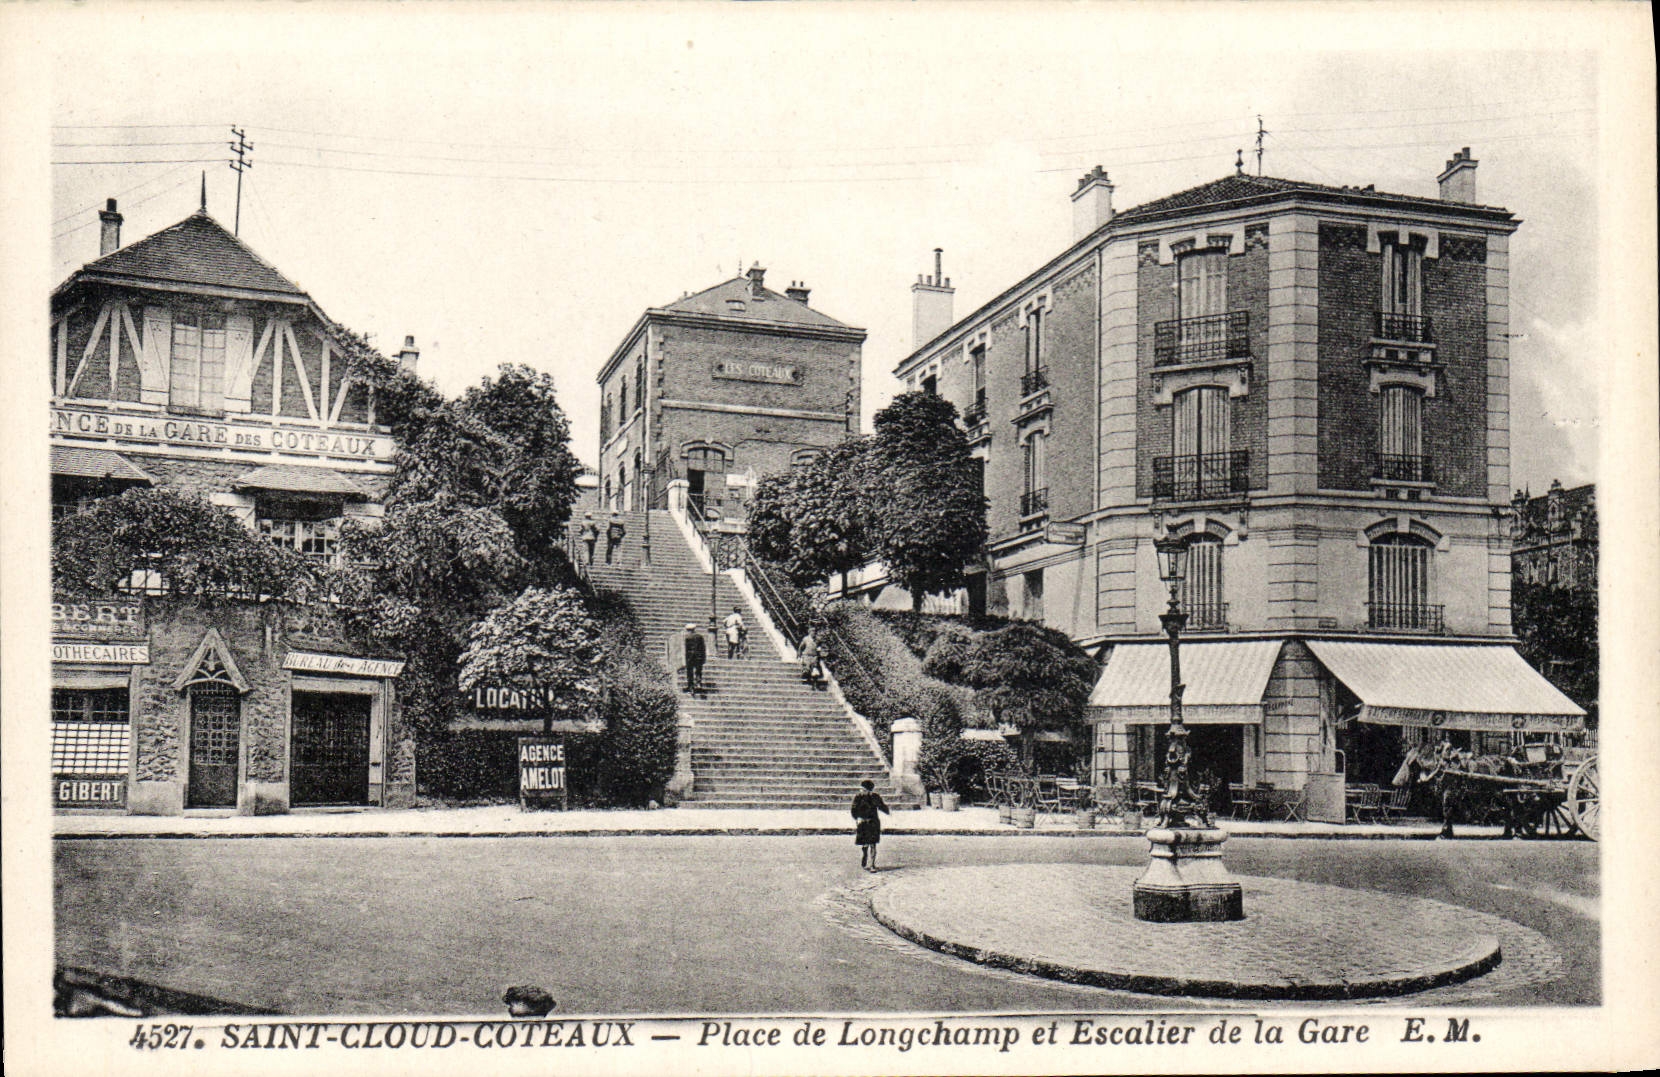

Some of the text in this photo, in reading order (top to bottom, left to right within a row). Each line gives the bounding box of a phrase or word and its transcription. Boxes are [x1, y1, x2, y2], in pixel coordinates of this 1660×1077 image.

[724, 361, 792, 380] LES COTEAUX
[114, 422, 133, 436] DE
[140, 425, 158, 438] LA
[163, 421, 229, 444] GARE
[234, 433, 262, 447] DES
[271, 431, 376, 456] COTEAUX
[53, 645, 148, 661] OTHECAIRES
[520, 744, 565, 762] AGENCE
[520, 767, 566, 789] AMELOT
[59, 780, 121, 801] GIBERT
